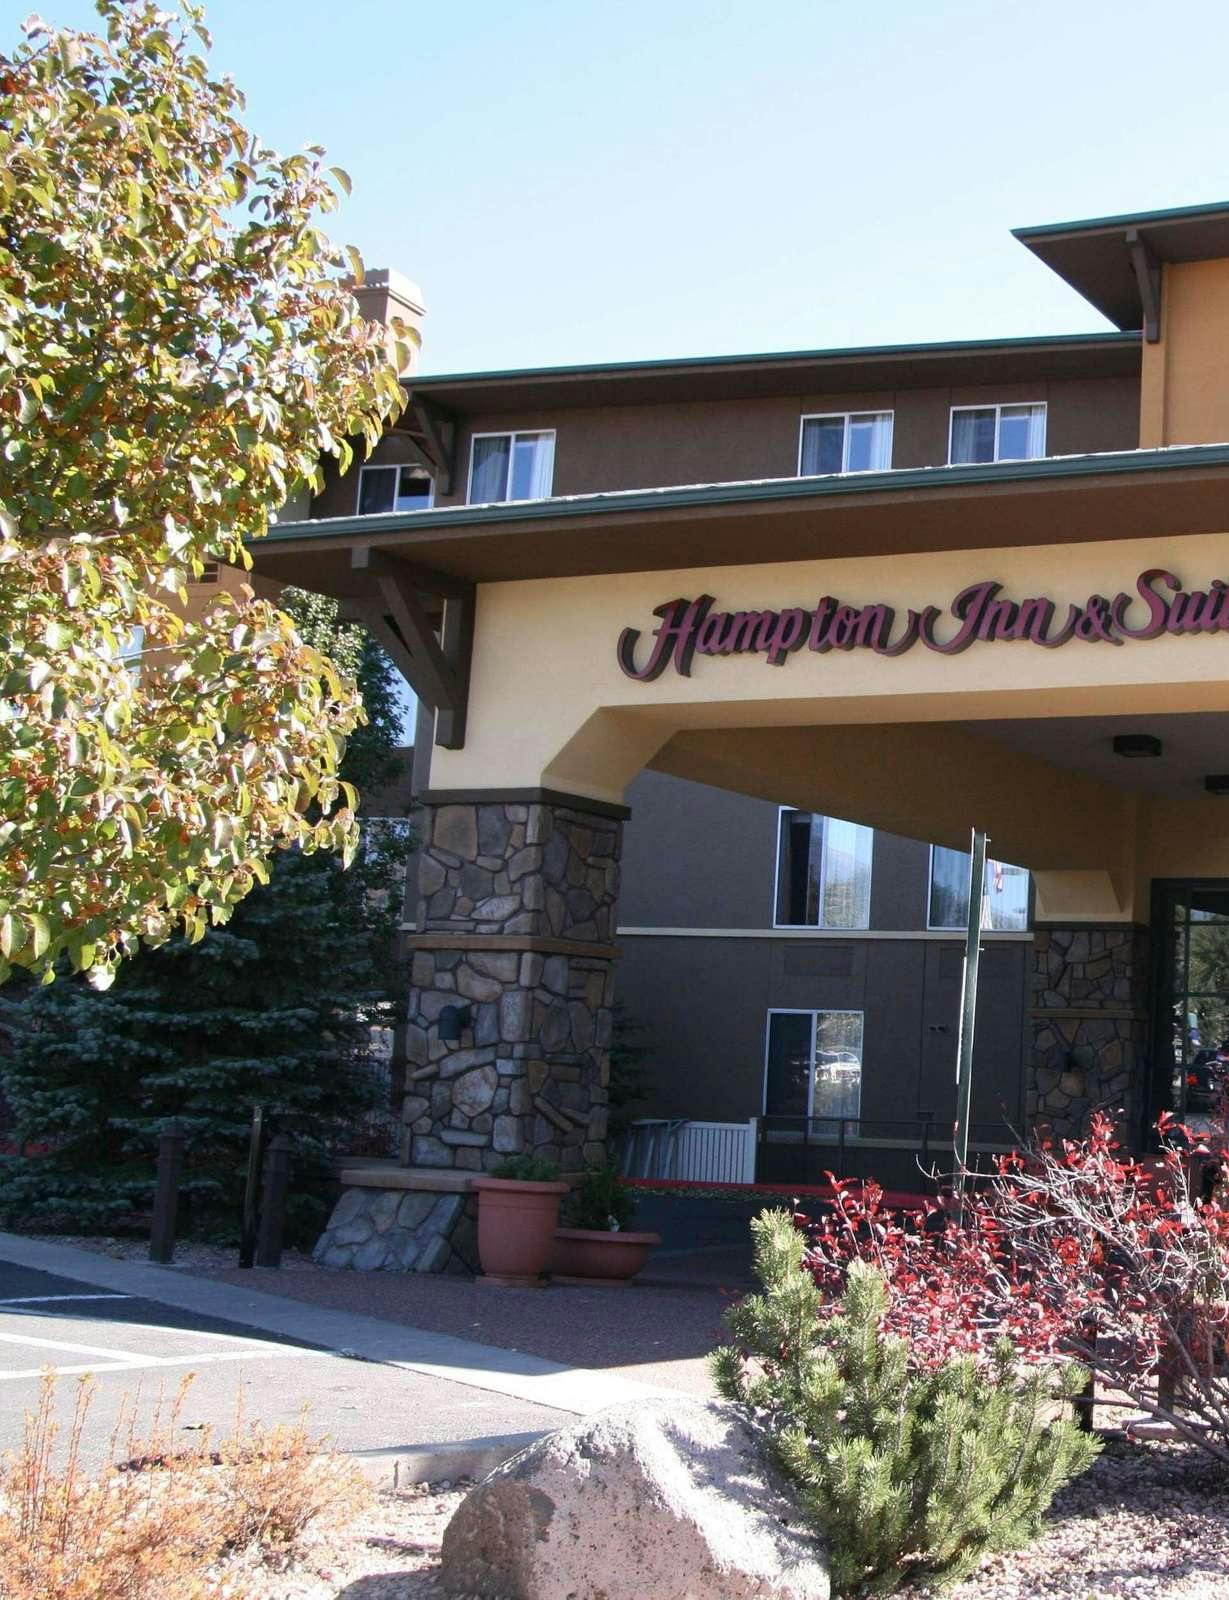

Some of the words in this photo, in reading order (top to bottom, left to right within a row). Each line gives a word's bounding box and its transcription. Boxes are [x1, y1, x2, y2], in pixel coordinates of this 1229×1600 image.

[617, 594, 923, 683] Hampton
[919, 581, 1084, 656] Inn
[1075, 594, 1125, 646] &
